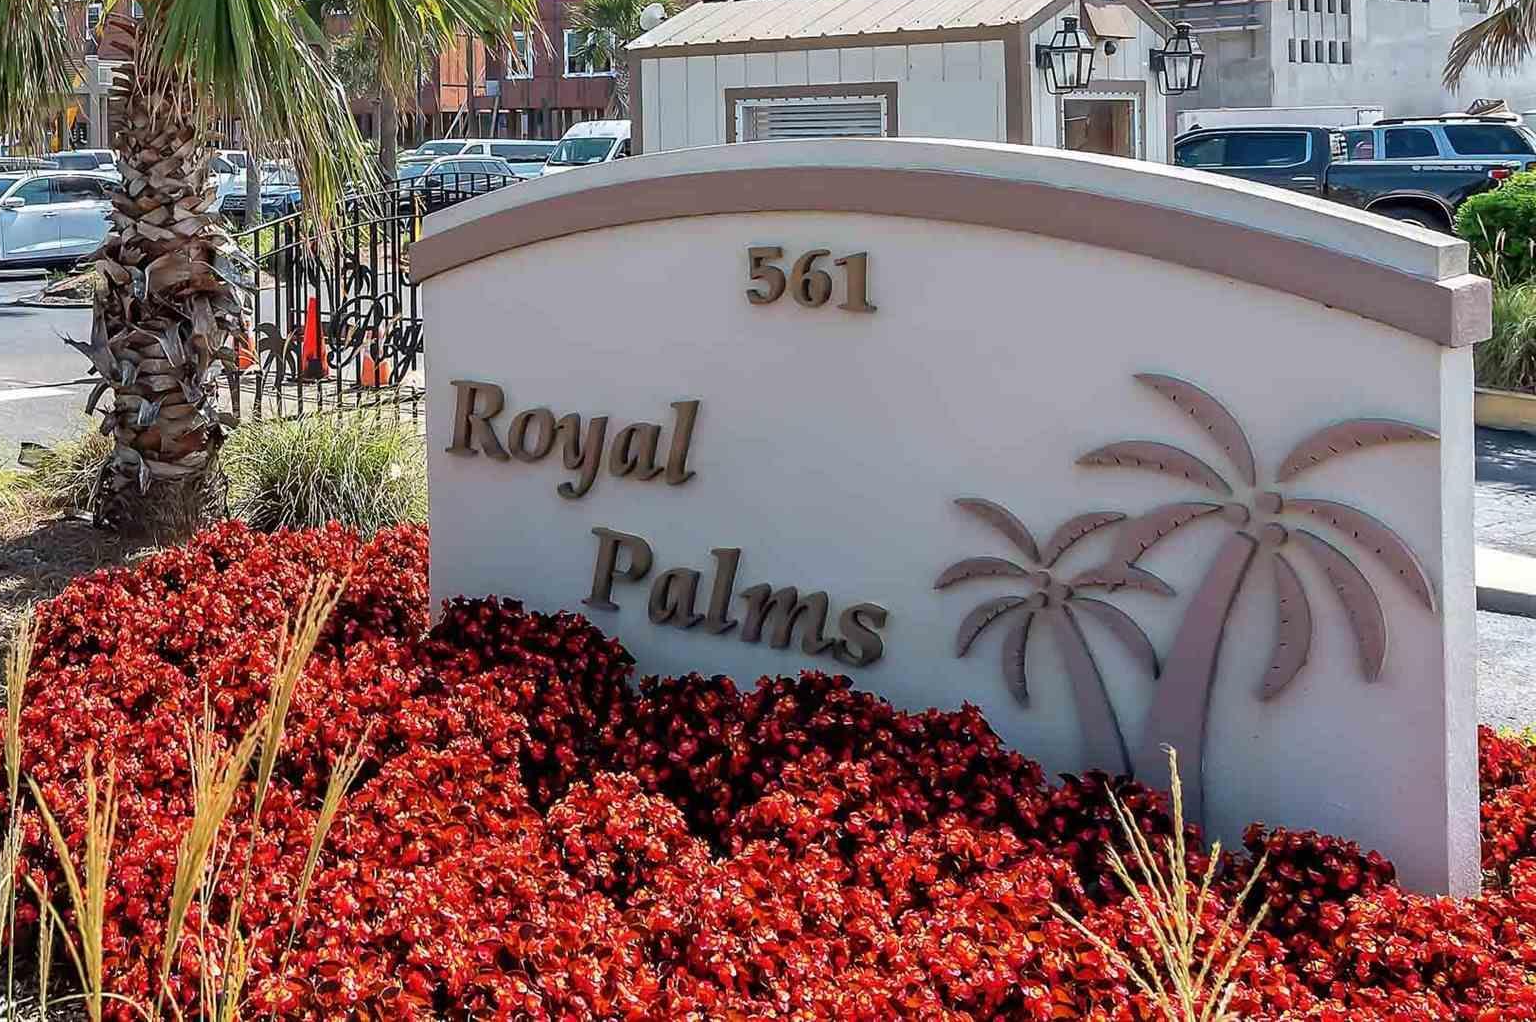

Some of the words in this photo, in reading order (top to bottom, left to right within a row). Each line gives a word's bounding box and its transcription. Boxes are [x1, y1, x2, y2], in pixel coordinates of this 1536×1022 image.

[746, 245, 878, 314] 561
[445, 378, 701, 499] Royal
[581, 526, 889, 668] Palms
